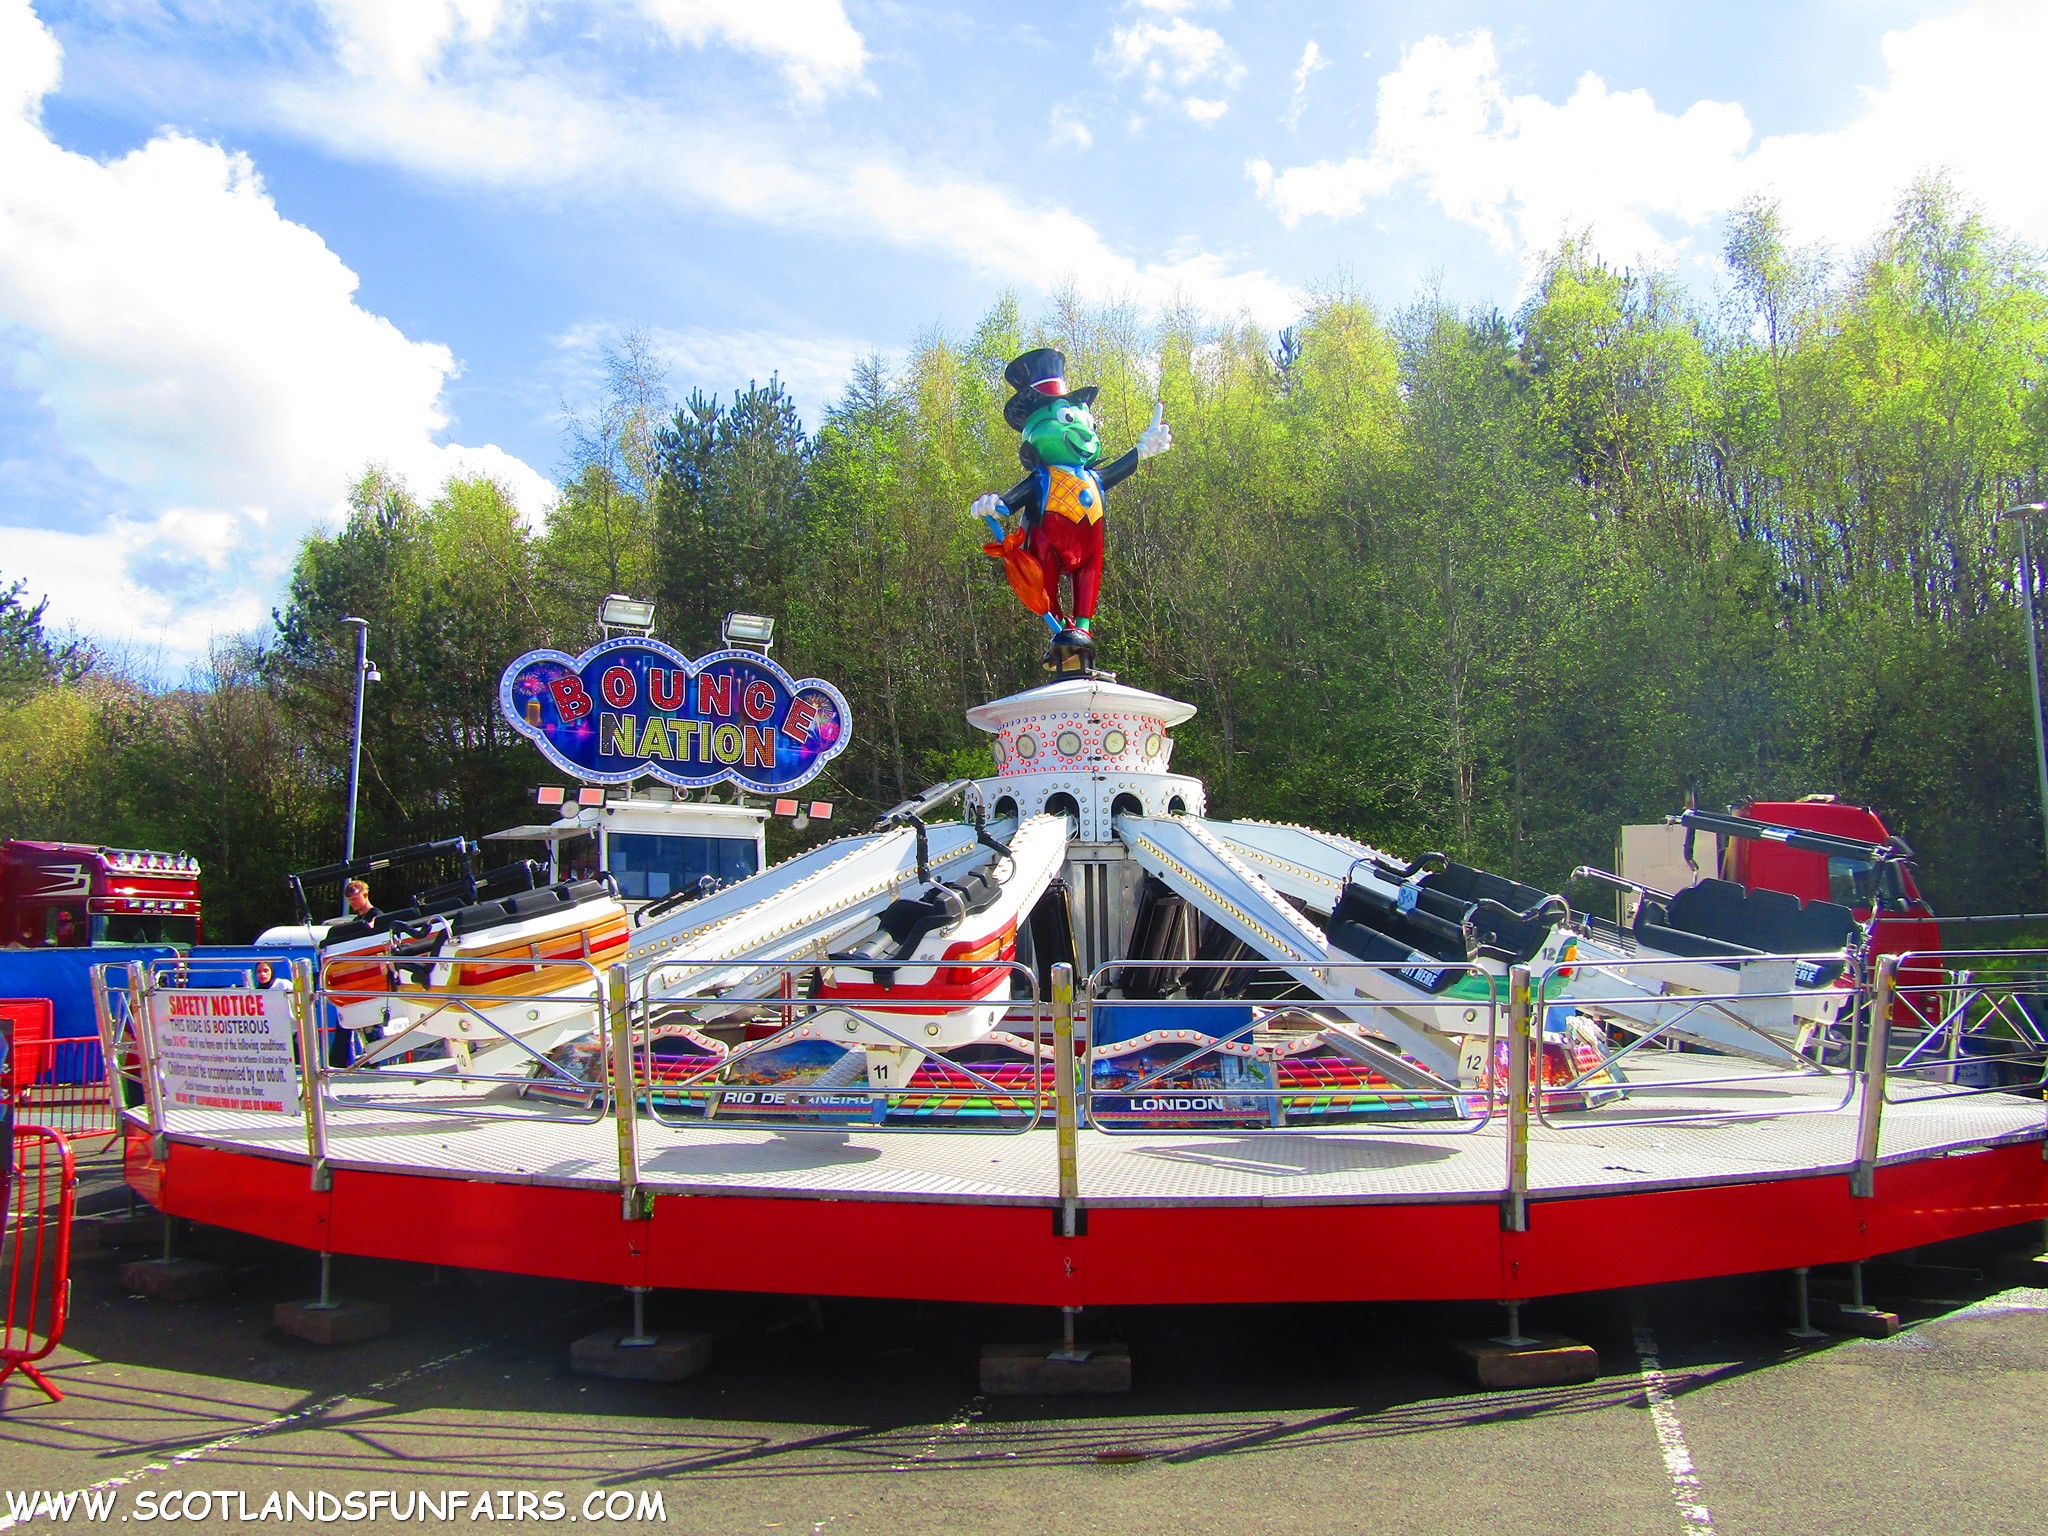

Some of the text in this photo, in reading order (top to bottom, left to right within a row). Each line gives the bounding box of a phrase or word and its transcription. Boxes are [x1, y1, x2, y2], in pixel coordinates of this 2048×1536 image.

[548, 665, 818, 744] BOUNCE
[600, 712, 776, 768] NATION
[169, 994, 265, 1017] SAFETY NOTICE
[169, 1019, 270, 1034] THIS RIDE IS BOISTEROUS
[1466, 1055, 1482, 1070] 12
[246, 1066, 255, 1085] by
[873, 1065, 888, 1079] 11
[723, 1092, 756, 1104] RIO
[760, 1093, 787, 1104] DE
[1130, 1098, 1224, 1111] LONDON
